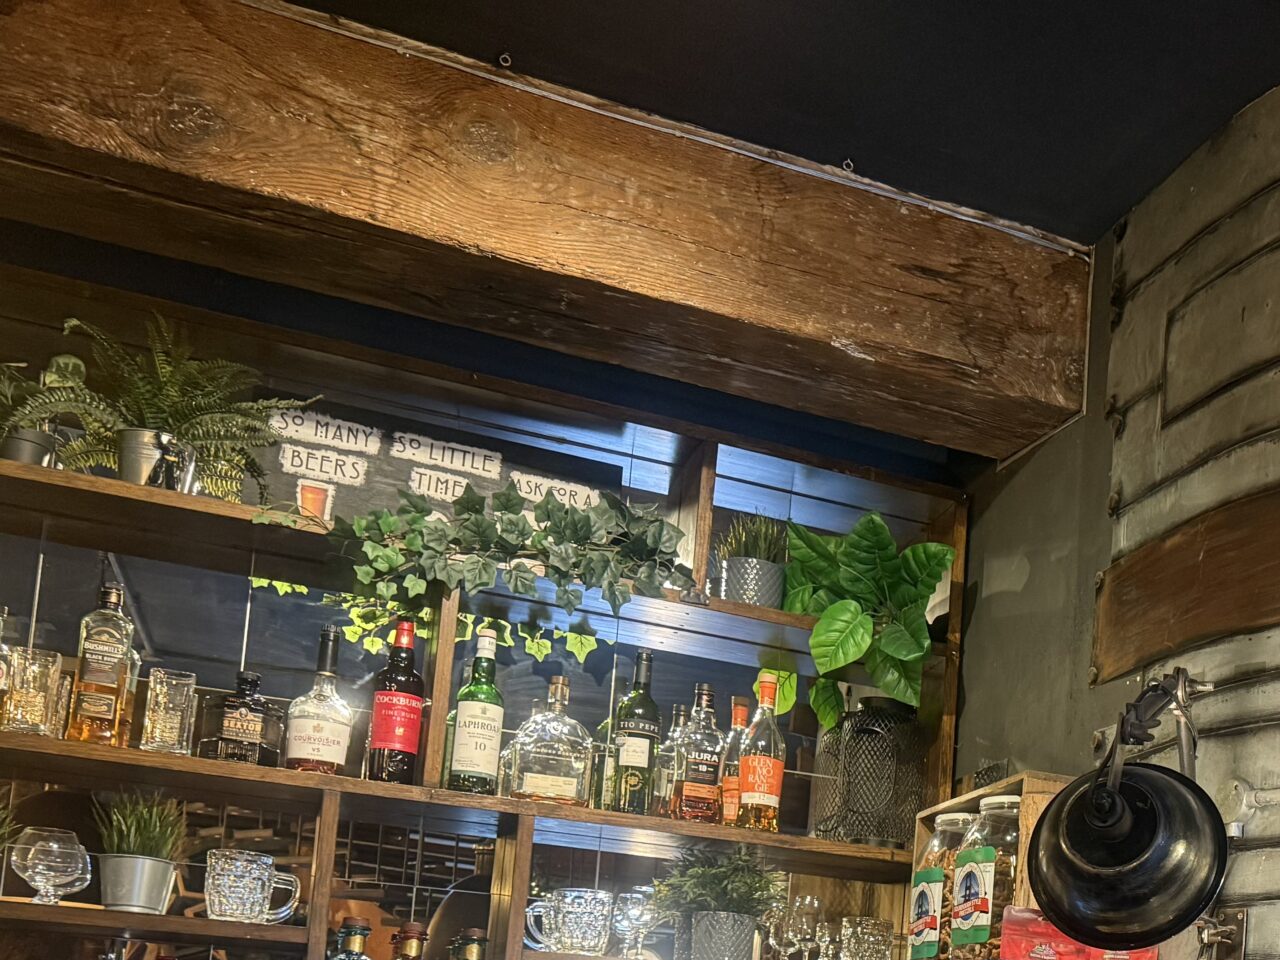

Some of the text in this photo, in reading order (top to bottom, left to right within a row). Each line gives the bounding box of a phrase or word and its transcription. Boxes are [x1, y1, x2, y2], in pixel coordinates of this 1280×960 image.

[277, 411, 375, 448] SO MANY
[395, 434, 496, 473] SO LITTLE
[289, 450, 362, 479] BEERS
[414, 471, 466, 498] TIME
[515, 478, 543, 497] ASK
[583, 493, 593, 507] A
[620, 720, 660, 734] TIO PEPE
[474, 741, 487, 752] 10
[688, 751, 719, 763] JURA
[749, 757, 773, 770] GLEN
[748, 773, 767, 784] RAN
[756, 766, 774, 778] MO
[754, 783, 770, 793] GIE
